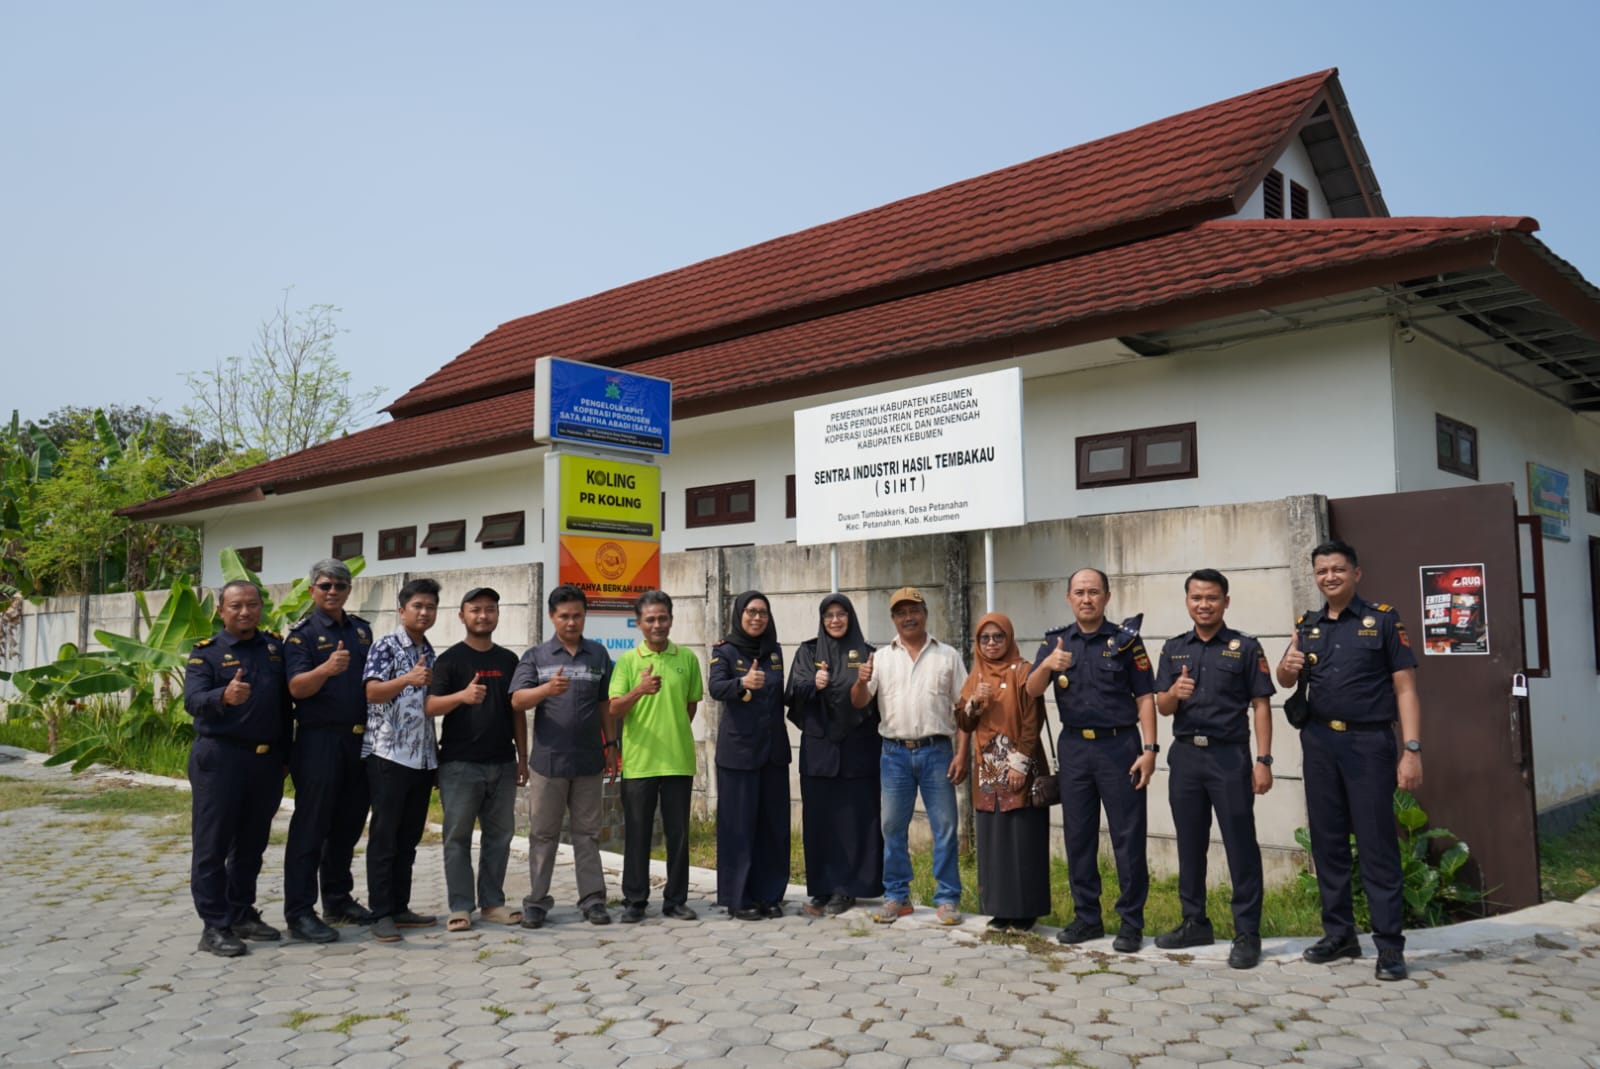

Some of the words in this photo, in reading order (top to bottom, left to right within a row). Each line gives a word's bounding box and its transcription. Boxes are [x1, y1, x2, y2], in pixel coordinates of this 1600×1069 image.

[573, 406, 611, 418] KOPERASI
[831, 406, 878, 421] PEMERINTAH
[881, 397, 928, 413] KABUPATEN
[930, 388, 972, 404] KEBUMEN
[560, 412, 580, 422] SATA
[582, 415, 606, 425] ARTHA
[826, 423, 848, 433] DINAS
[850, 411, 912, 429] PERINDUSTRIAN
[914, 399, 978, 418] PERDAGANGAN
[825, 432, 861, 444] KOPERASI
[863, 428, 888, 438] USAHA
[891, 423, 913, 434] KECIL
[916, 420, 932, 429] DAN
[934, 410, 980, 426] MENENGAH
[858, 438, 902, 449] KABUPATEN
[904, 429, 943, 442] KEBUMEN
[814, 469, 851, 484] SENTRA
[854, 461, 899, 479] INDUSTRI
[902, 458, 932, 473] HASIL
[935, 447, 995, 468] TEMBAKAU
[587, 470, 635, 489] KOLING
[580, 492, 595, 504] PR
[599, 494, 641, 509] KOLING
[838, 512, 859, 522] Dusun
[862, 507, 907, 520] Tumbakkeris,
[909, 505, 927, 514] Desa
[929, 501, 968, 511] Petanahan
[846, 522, 859, 531] Kec.
[863, 518, 902, 529] Petanahan,
[905, 515, 920, 525] Kab.
[923, 512, 960, 522] Kebumen
[602, 584, 632, 592] BERKAH
[606, 638, 635, 650] UNIX
